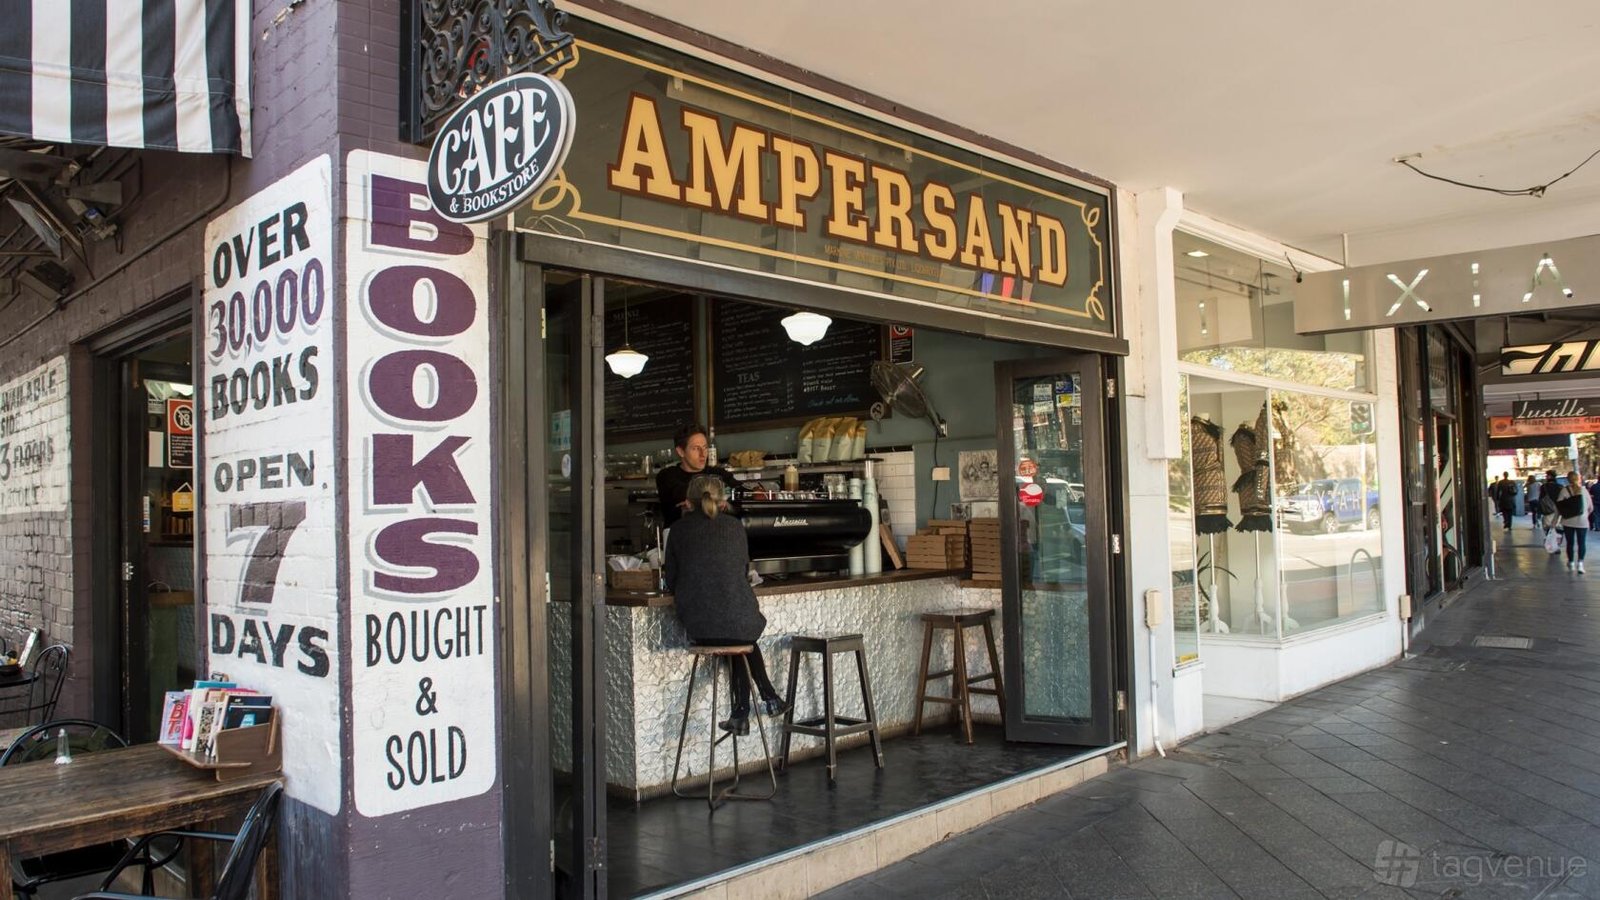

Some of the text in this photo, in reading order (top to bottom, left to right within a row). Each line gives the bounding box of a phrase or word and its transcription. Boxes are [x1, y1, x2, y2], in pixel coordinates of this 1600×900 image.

[437, 88, 551, 195] CAFE
[449, 158, 540, 214] & BOOKSTORE
[607, 92, 1071, 288] AMPERSAND
[213, 201, 311, 288] OVER
[209, 257, 325, 362] 30,000
[1342, 252, 1573, 320] IXIA
[1, 370, 57, 413] AVAILABLE
[212, 345, 319, 421] BOOKS
[367, 173, 480, 594] BOOKS
[737, 371, 761, 385] TEAS
[1515, 399, 1589, 418] Lucille
[0, 437, 55, 482] 3 FLOORS
[214, 449, 315, 493] OPEN
[228, 501, 307, 604] 7
[211, 613, 330, 678] DAYS
[365, 605, 487, 667] BOUGHT
[416, 676, 438, 717] &
[385, 725, 467, 791] SOLD
